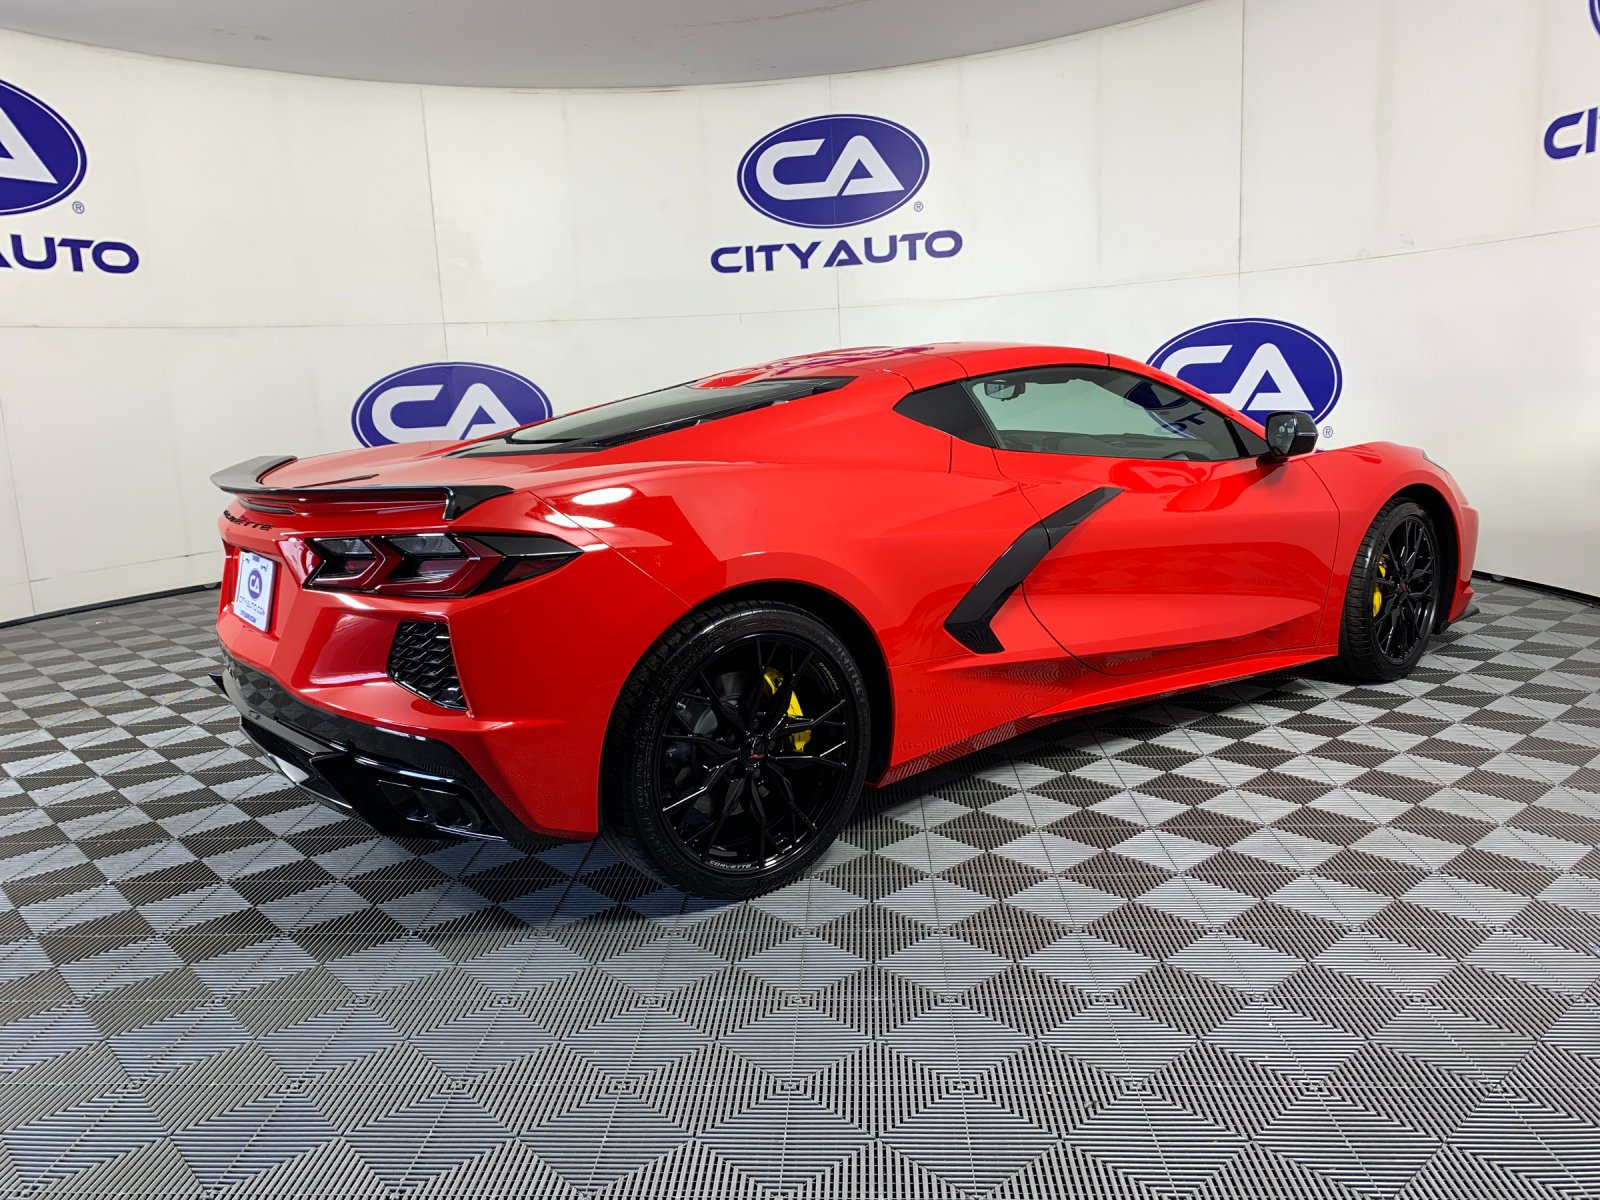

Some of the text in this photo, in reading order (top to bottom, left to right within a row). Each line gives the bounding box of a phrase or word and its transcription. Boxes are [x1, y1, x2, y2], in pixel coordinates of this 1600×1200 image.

[756, 135, 905, 200] CA
[0, 234, 140, 274] UTO
[1160, 343, 1315, 411] CA
[371, 383, 521, 443] CA
[709, 860, 752, 869] CORVETTE
